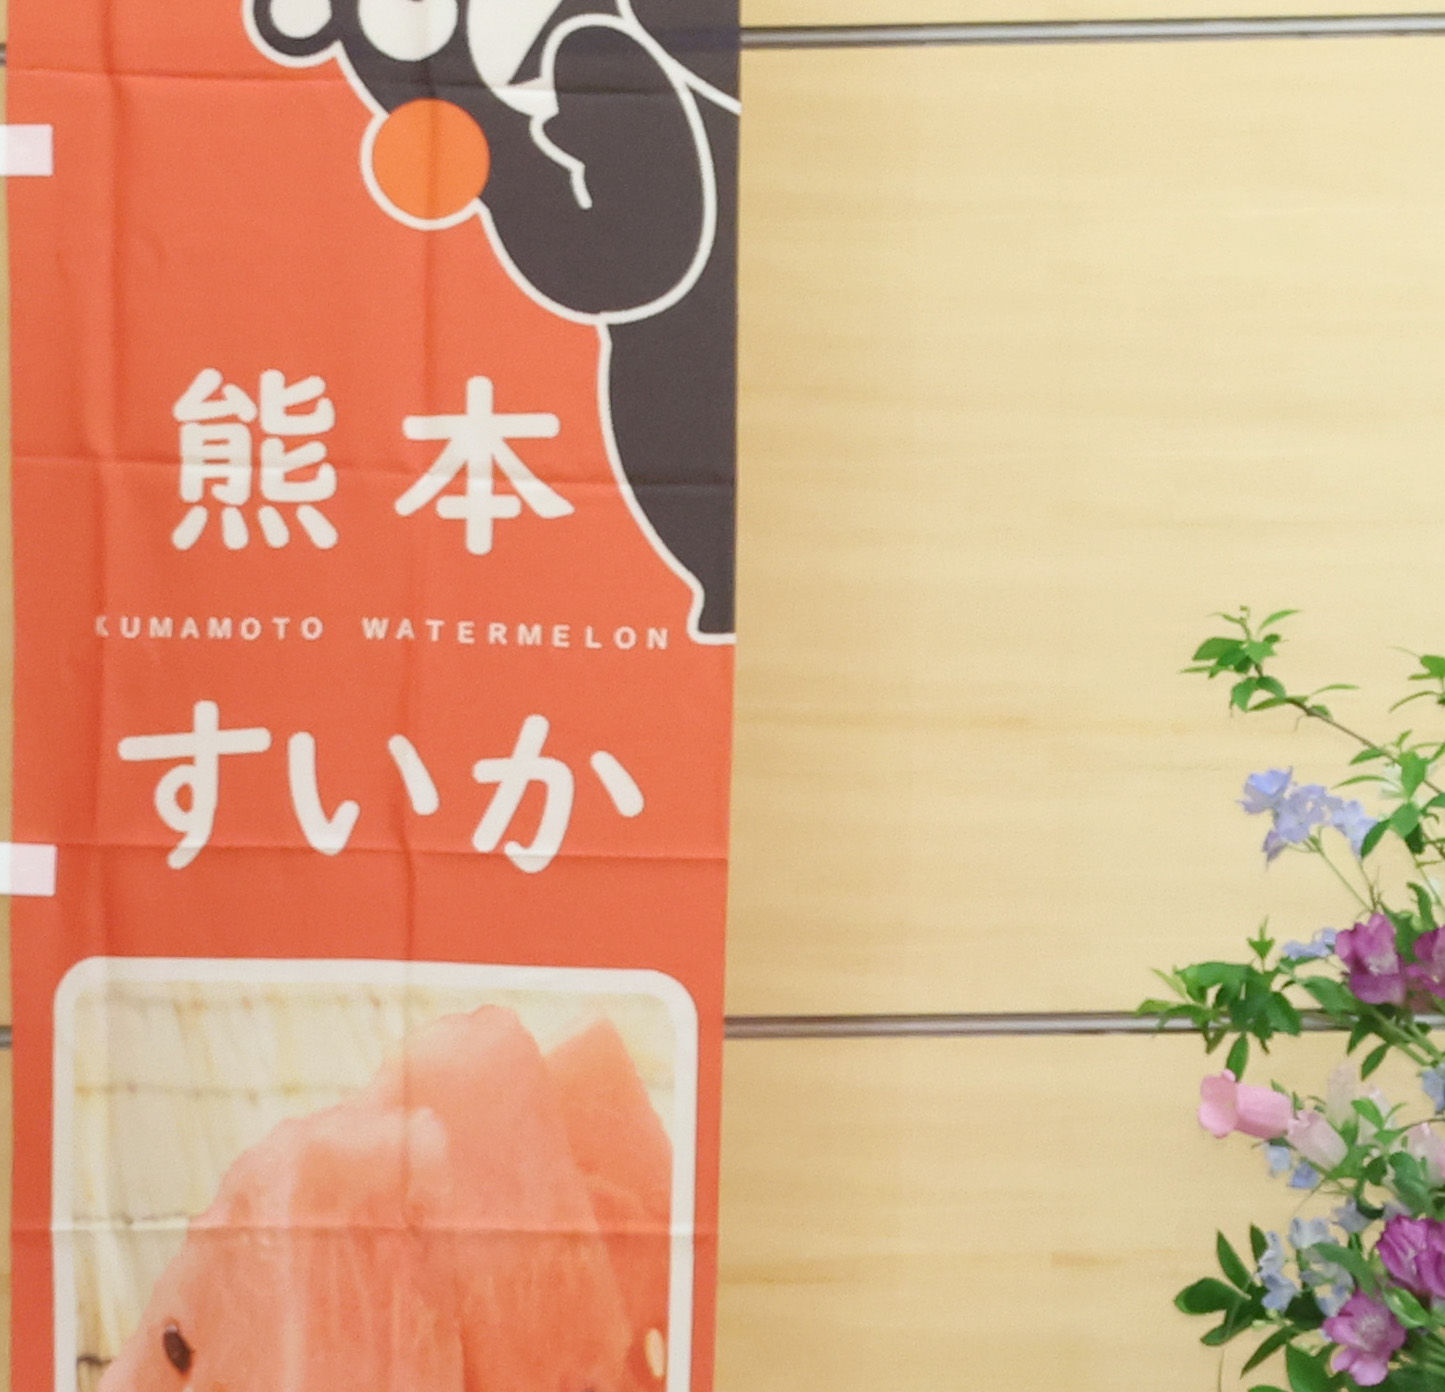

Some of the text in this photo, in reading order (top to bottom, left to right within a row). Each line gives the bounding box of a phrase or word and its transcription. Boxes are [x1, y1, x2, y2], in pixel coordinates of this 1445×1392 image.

[171, 367, 576, 555] 熊本
[95, 615, 669, 649] KUMAMOTO WATERMELON
[117, 699, 645, 873] すいか
